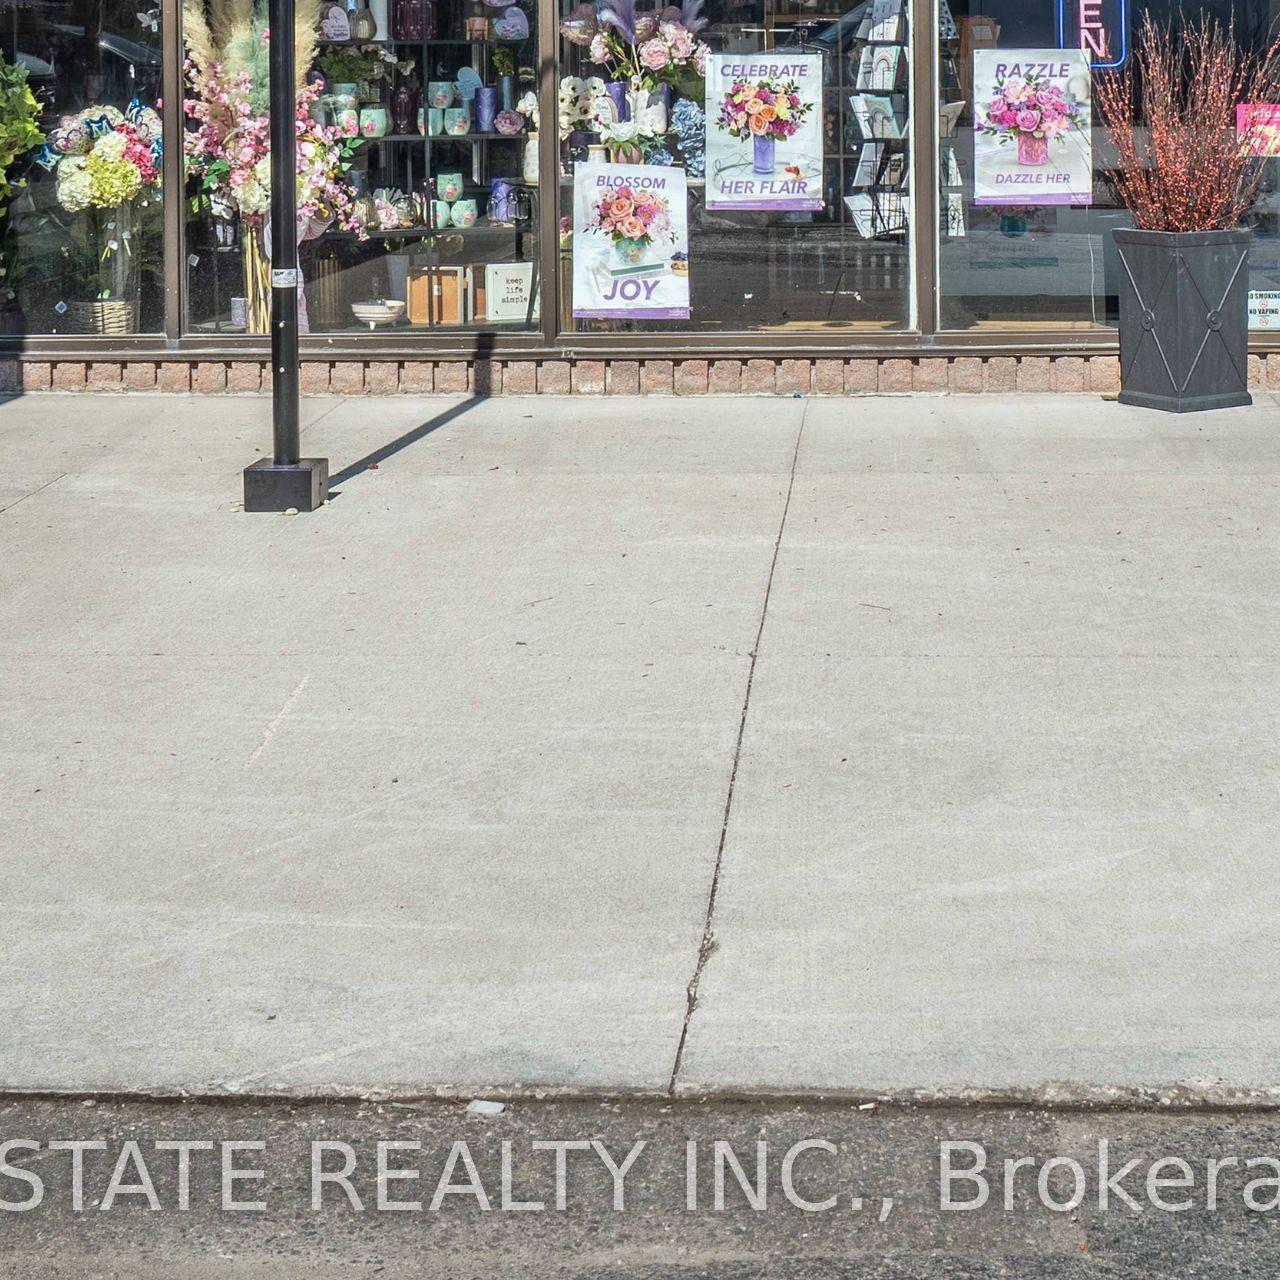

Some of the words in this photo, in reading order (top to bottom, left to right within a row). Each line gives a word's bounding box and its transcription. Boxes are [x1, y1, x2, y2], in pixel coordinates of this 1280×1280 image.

[720, 63, 809, 78] CELEBRATE
[994, 63, 1071, 79] RAZZLE
[595, 174, 667, 190] BLOSSOM
[995, 173, 1043, 184] DAZZLE
[1046, 173, 1071, 184] HER
[720, 180, 756, 196] HER
[759, 179, 809, 195] FLAIR
[505, 276, 524, 286] keep
[505, 286, 524, 294] life
[602, 278, 661, 301] JOY
[501, 295, 528, 305] simple
